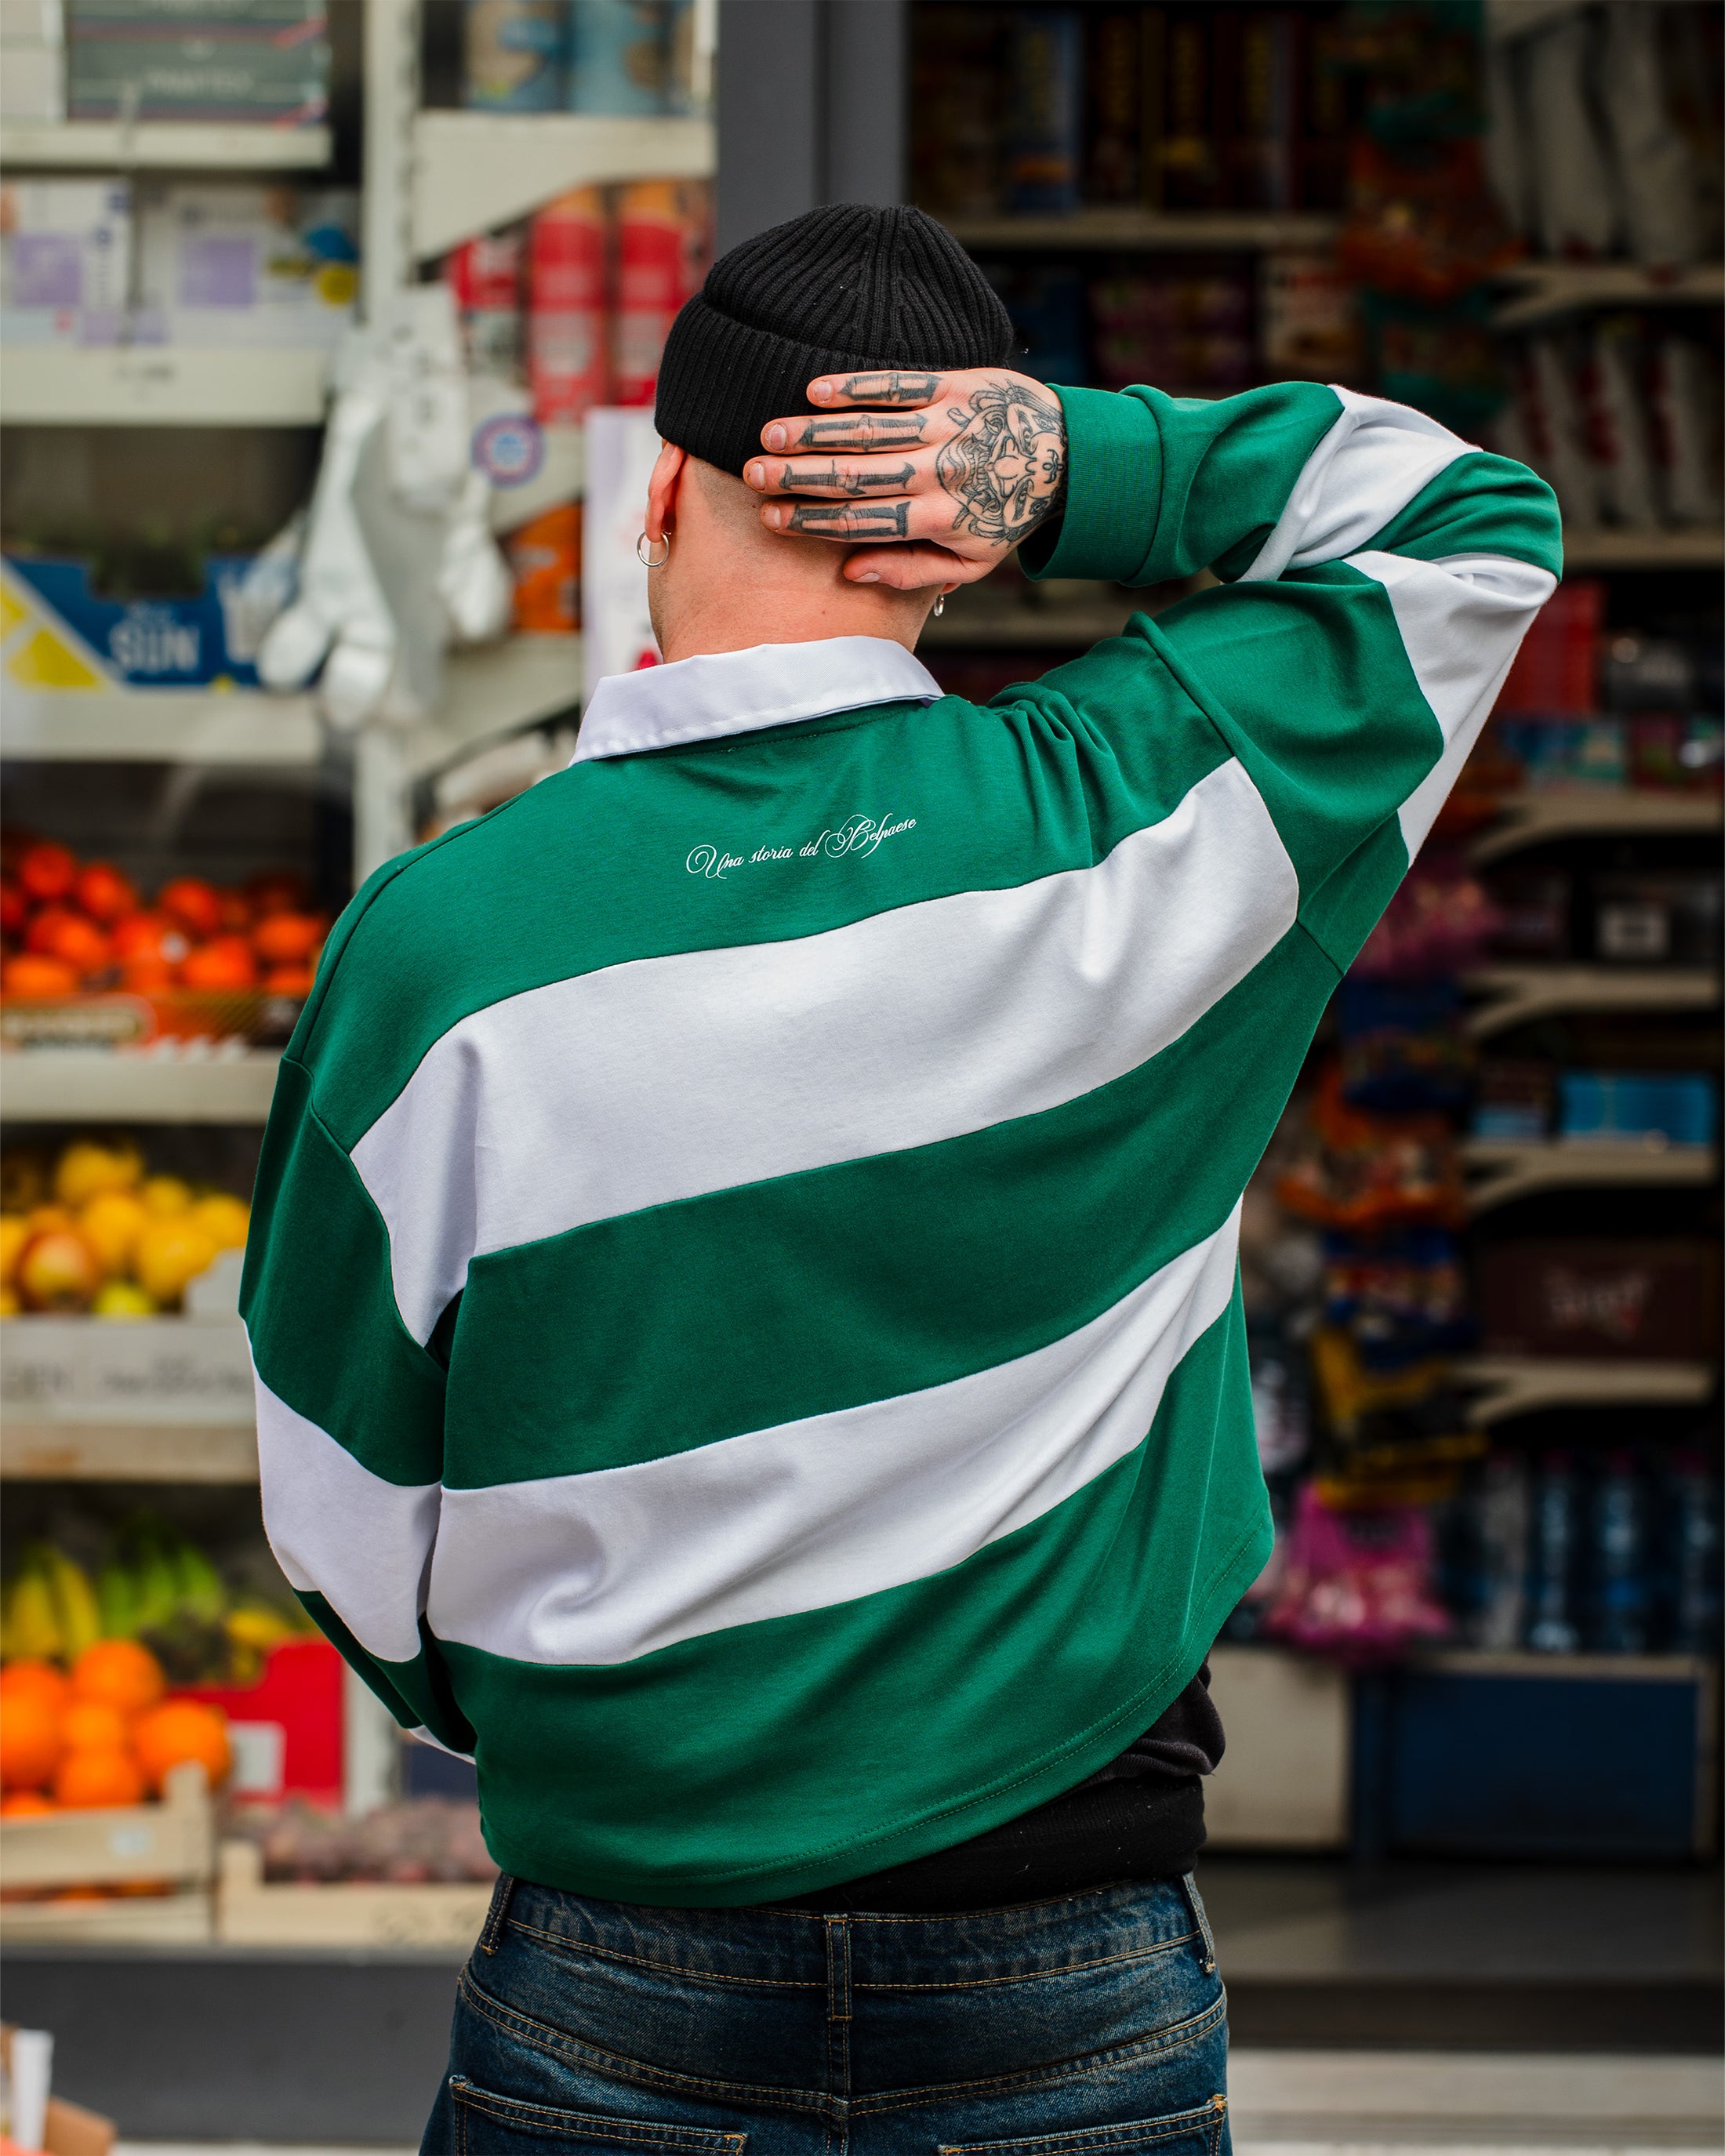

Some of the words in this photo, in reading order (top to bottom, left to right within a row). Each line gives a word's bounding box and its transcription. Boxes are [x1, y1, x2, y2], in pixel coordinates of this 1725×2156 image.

[685, 844, 745, 880] Una
[748, 844, 794, 863] storia
[799, 829, 831, 857] del
[824, 812, 917, 859] Belpaese
